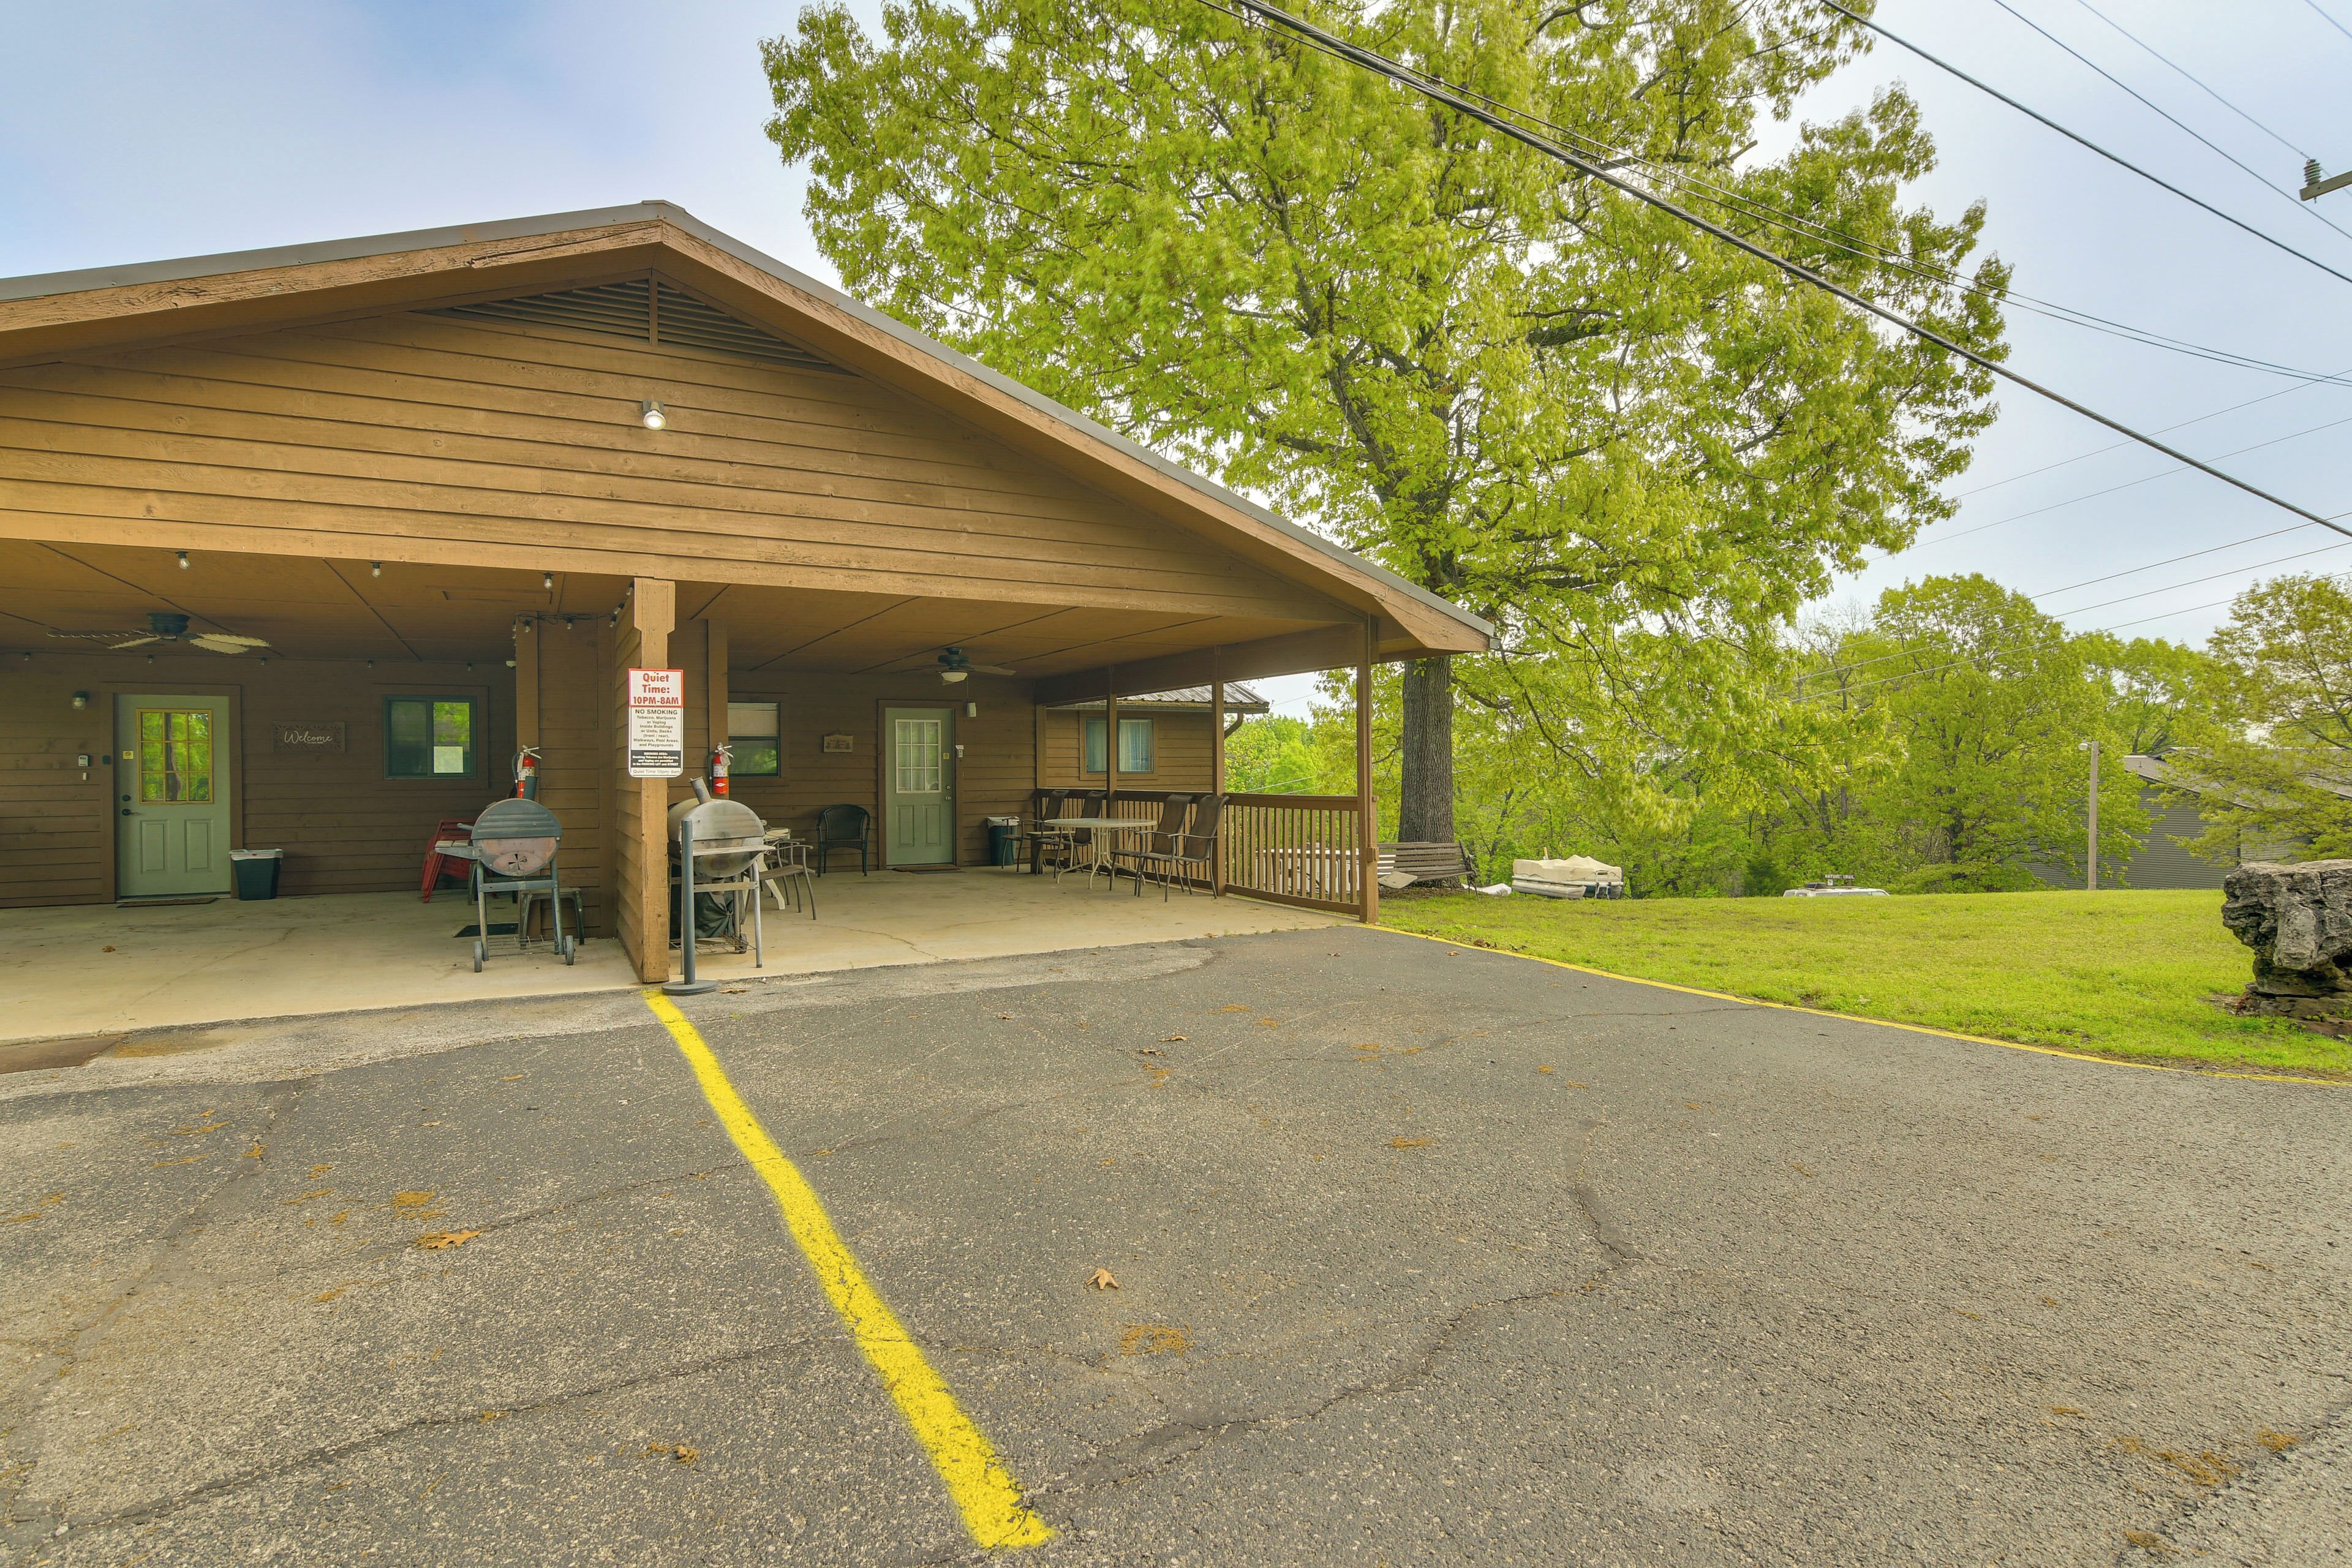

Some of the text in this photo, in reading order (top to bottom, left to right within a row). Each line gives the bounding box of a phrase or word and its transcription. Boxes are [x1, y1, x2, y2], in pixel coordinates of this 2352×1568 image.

[643, 673, 669, 682] Quiet
[643, 684, 670, 693] Time:
[285, 731, 333, 744] Welcome
